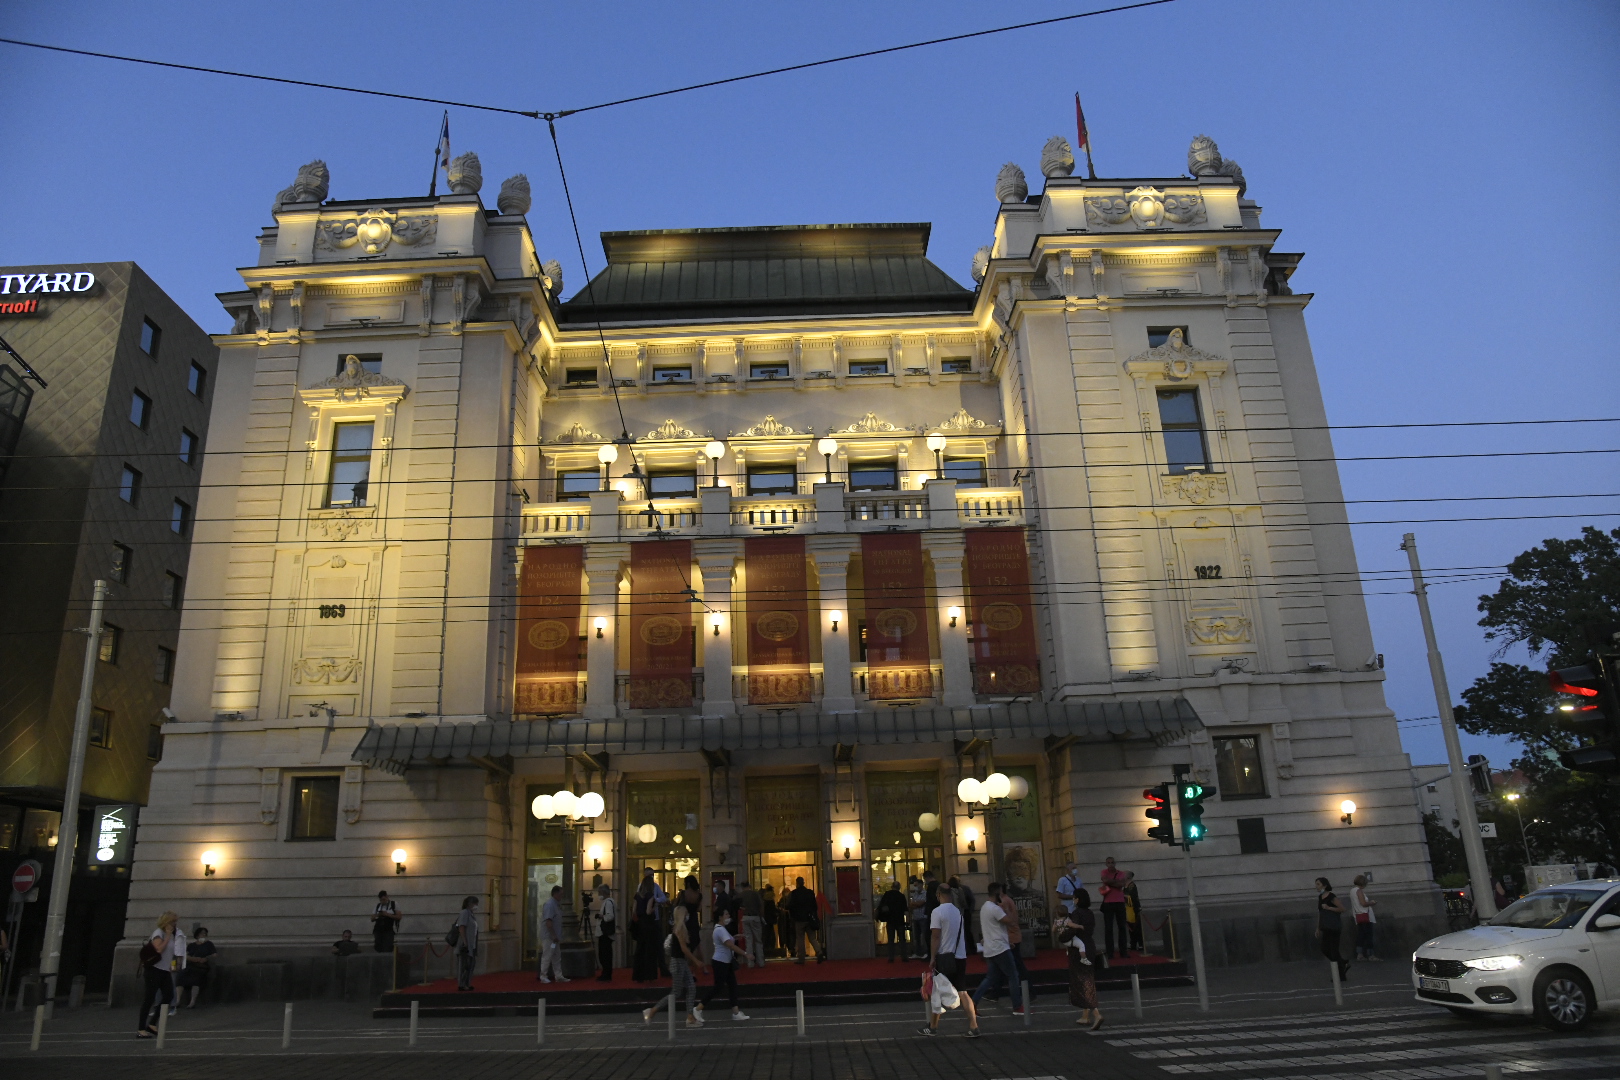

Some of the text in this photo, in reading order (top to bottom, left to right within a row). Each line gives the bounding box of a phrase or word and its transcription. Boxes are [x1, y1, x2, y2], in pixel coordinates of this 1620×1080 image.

[871, 549, 912, 557] NATIONAL
[972, 553, 1021, 561] ПОЗОРИШТЕ
[528, 563, 577, 571] НАРОДНО
[982, 562, 1022, 570] БЕОГРАДУ
[1194, 565, 1222, 580] 1922
[319, 604, 346, 618] 1869
